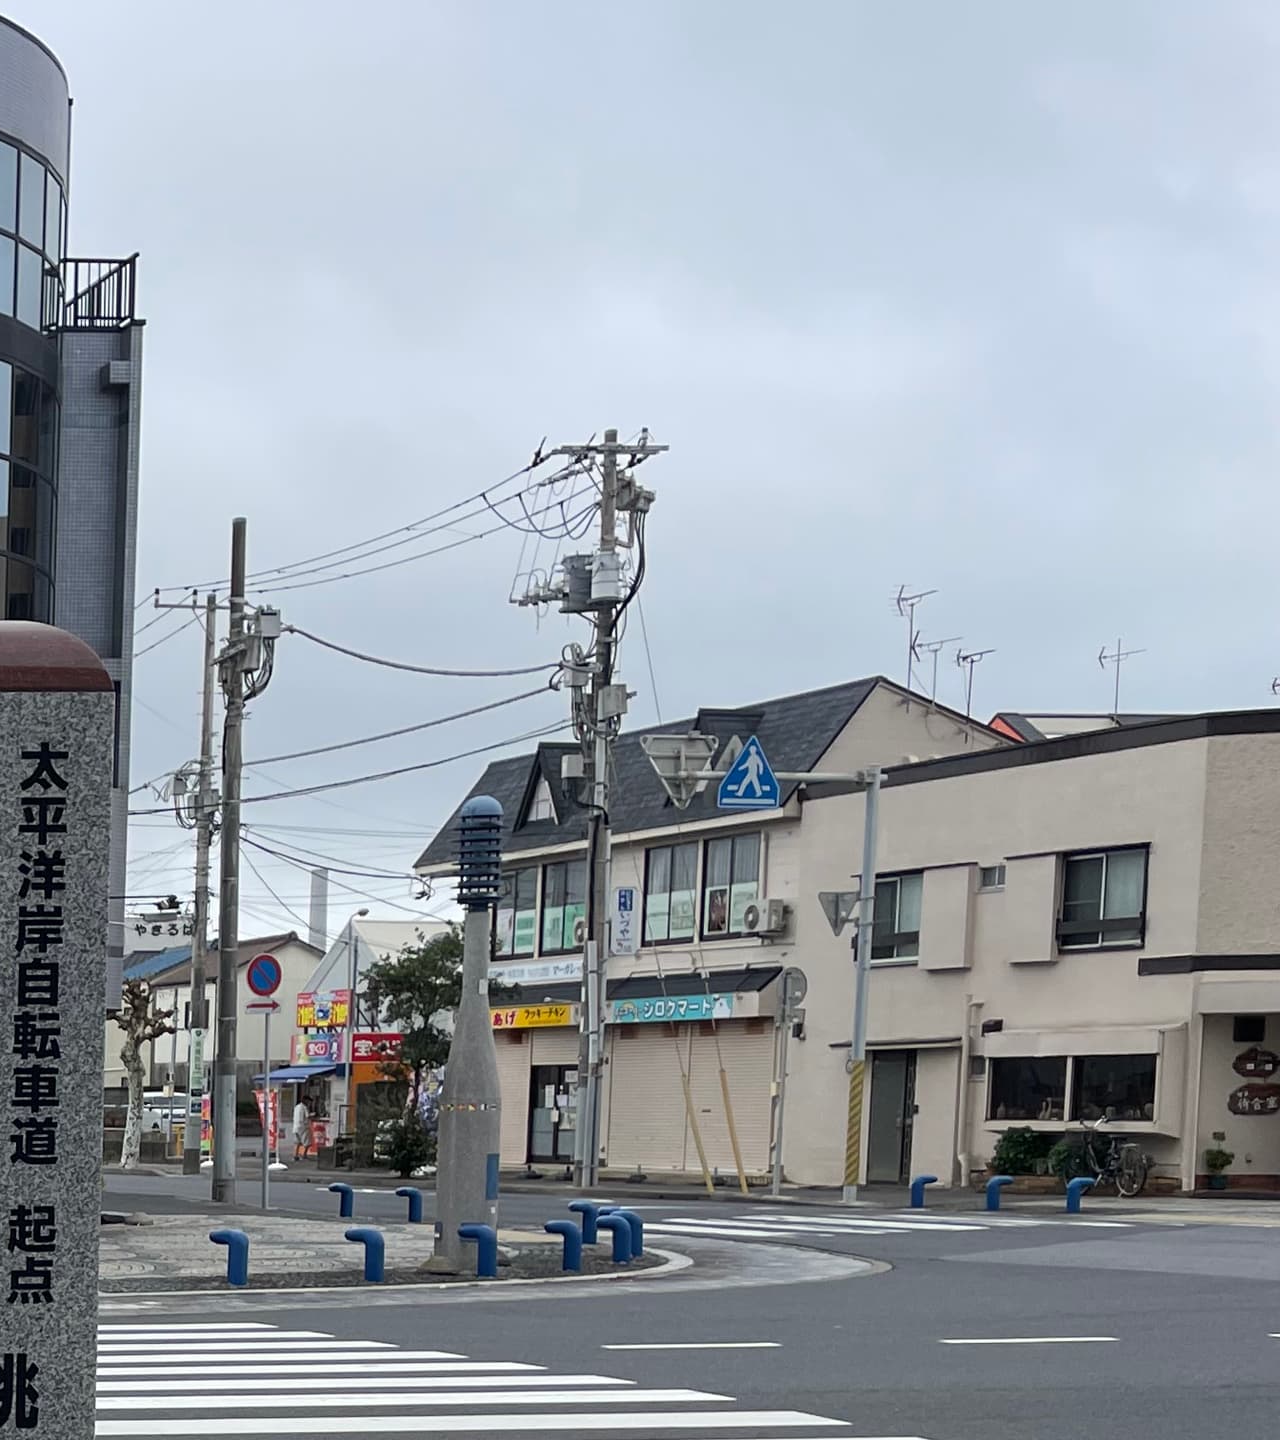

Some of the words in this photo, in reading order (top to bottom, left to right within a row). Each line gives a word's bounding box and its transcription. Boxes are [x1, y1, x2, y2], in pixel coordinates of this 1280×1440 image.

[10, 741, 70, 1166] 太平洋岸自転車道
[643, 999, 712, 1019] シロクマート
[7, 1205, 58, 1304] 起点
